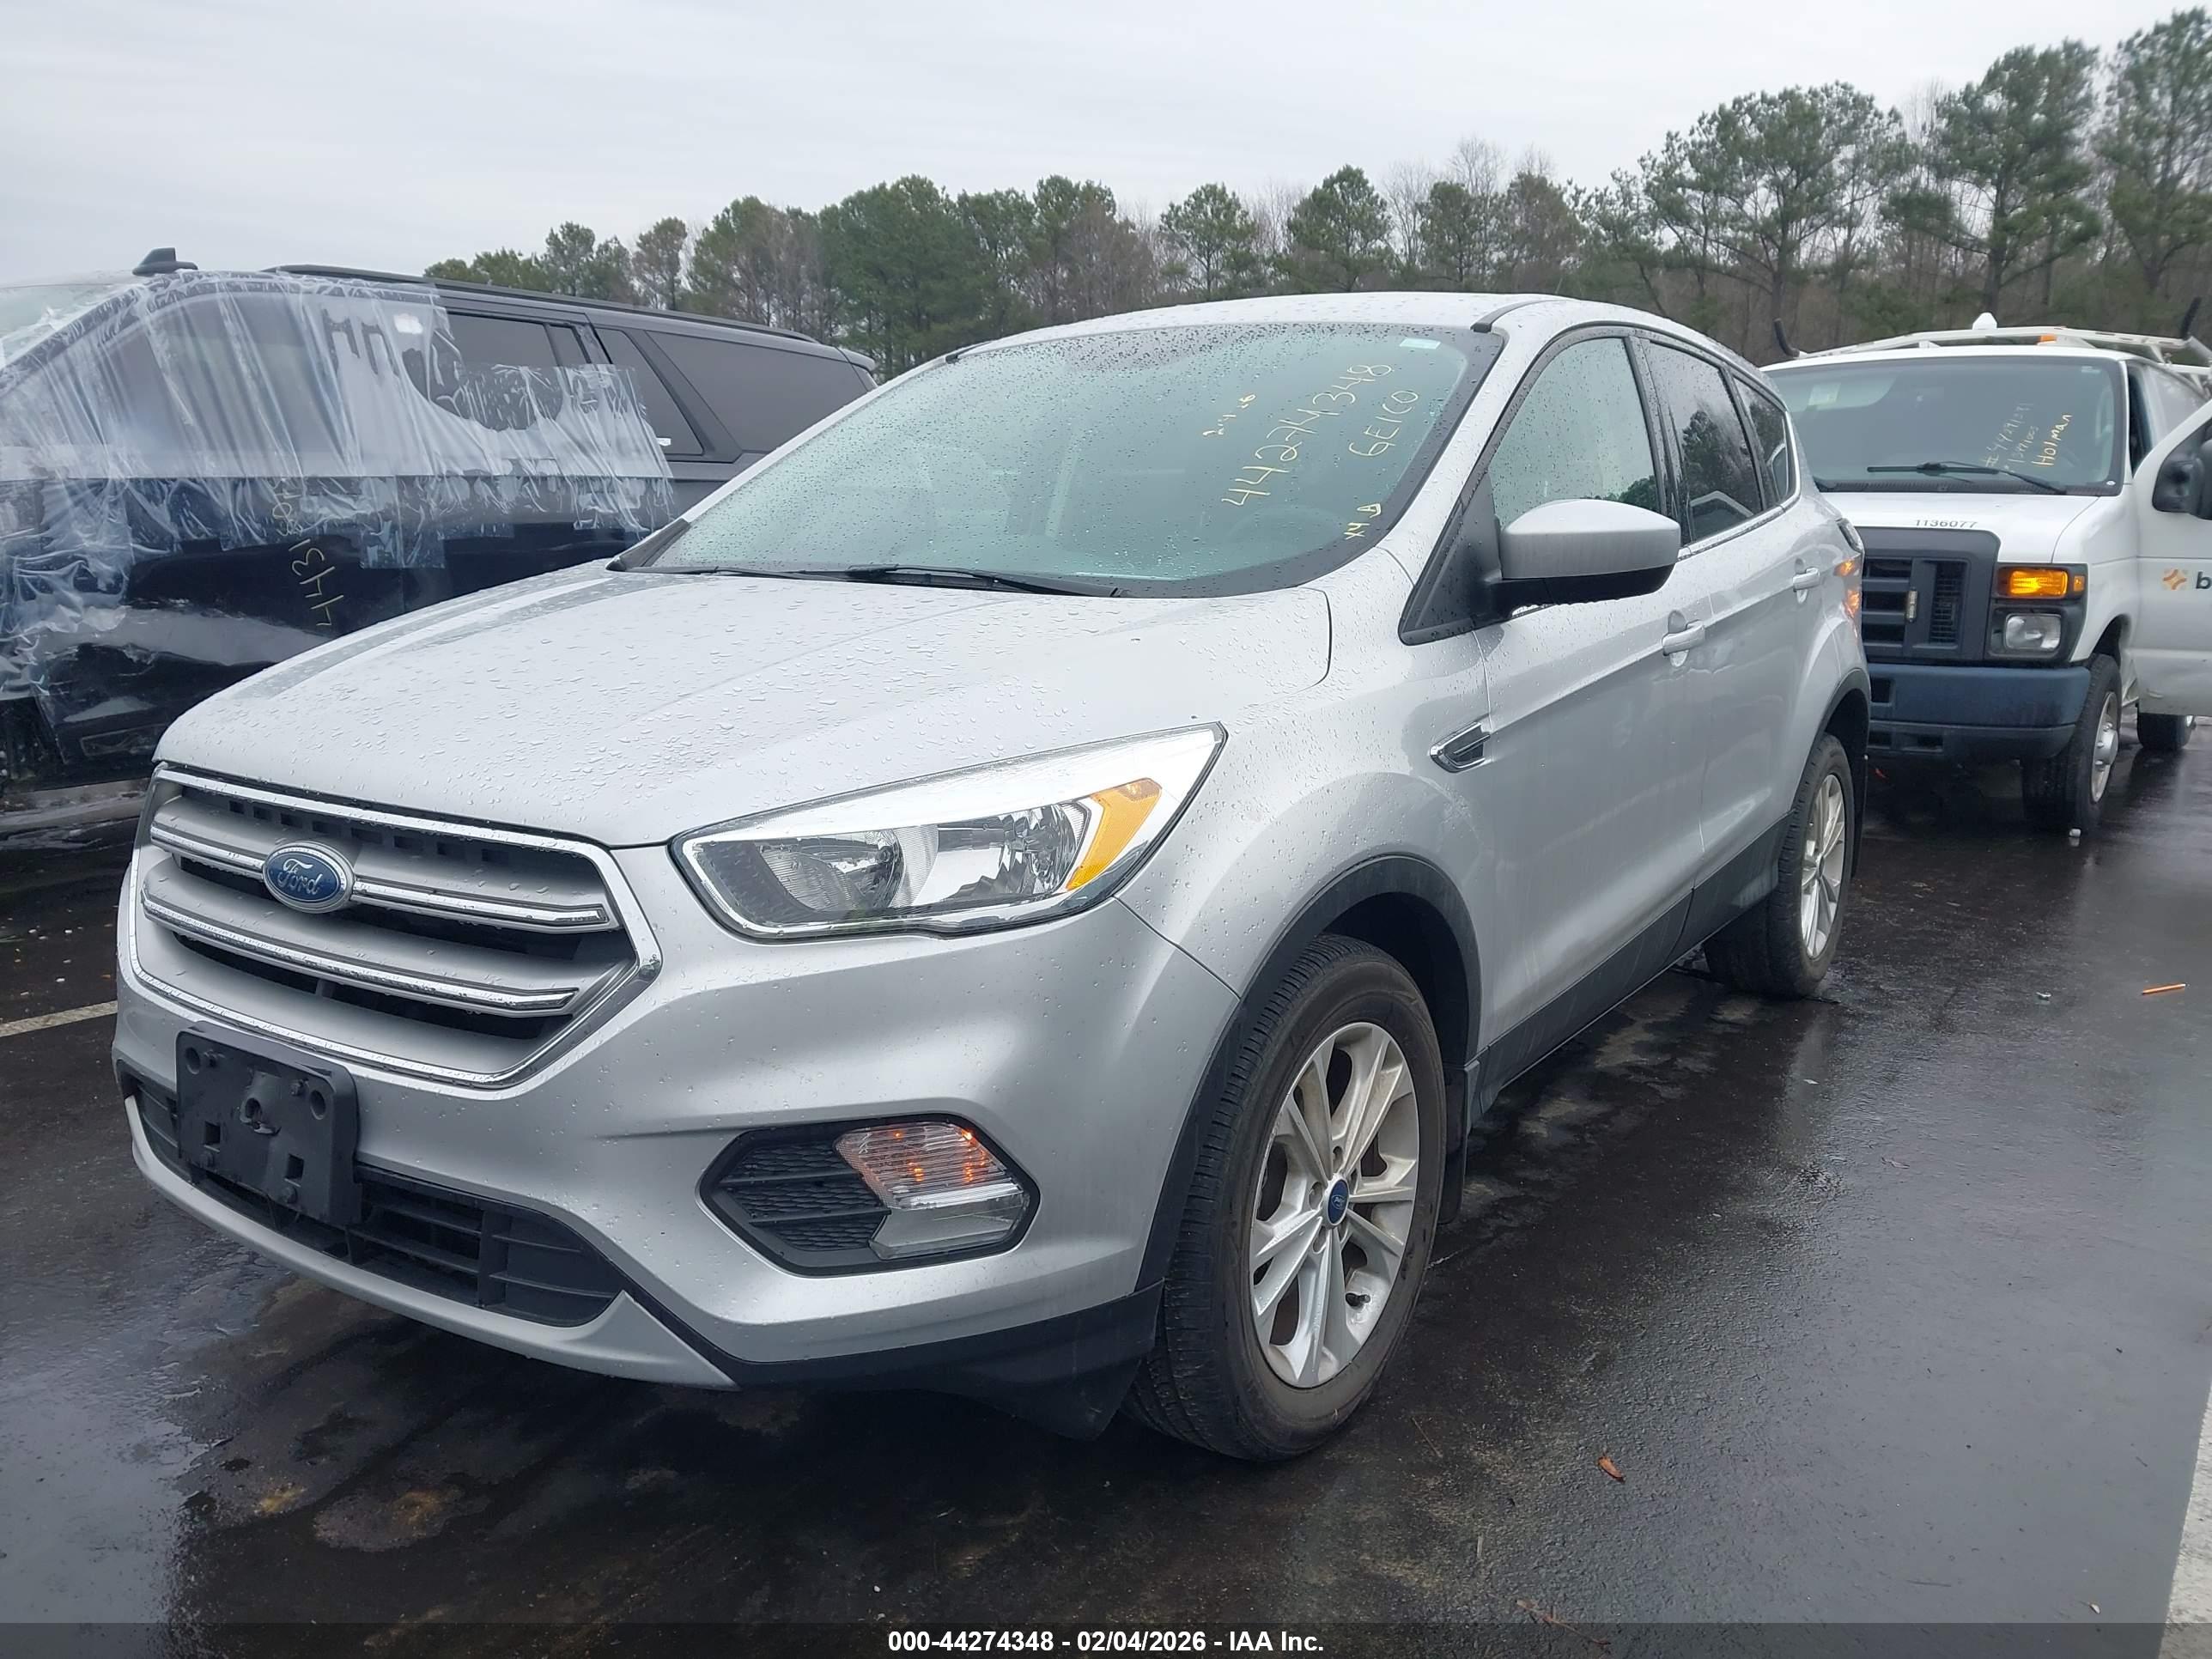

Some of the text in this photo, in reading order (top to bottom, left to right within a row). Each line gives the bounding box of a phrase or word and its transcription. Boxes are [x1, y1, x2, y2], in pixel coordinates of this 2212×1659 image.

[1348, 390, 1419, 457] GEICO
[2031, 414, 2073, 465] Holman
[1915, 519, 1978, 529] 1136077
[276, 858, 324, 896] Ford
